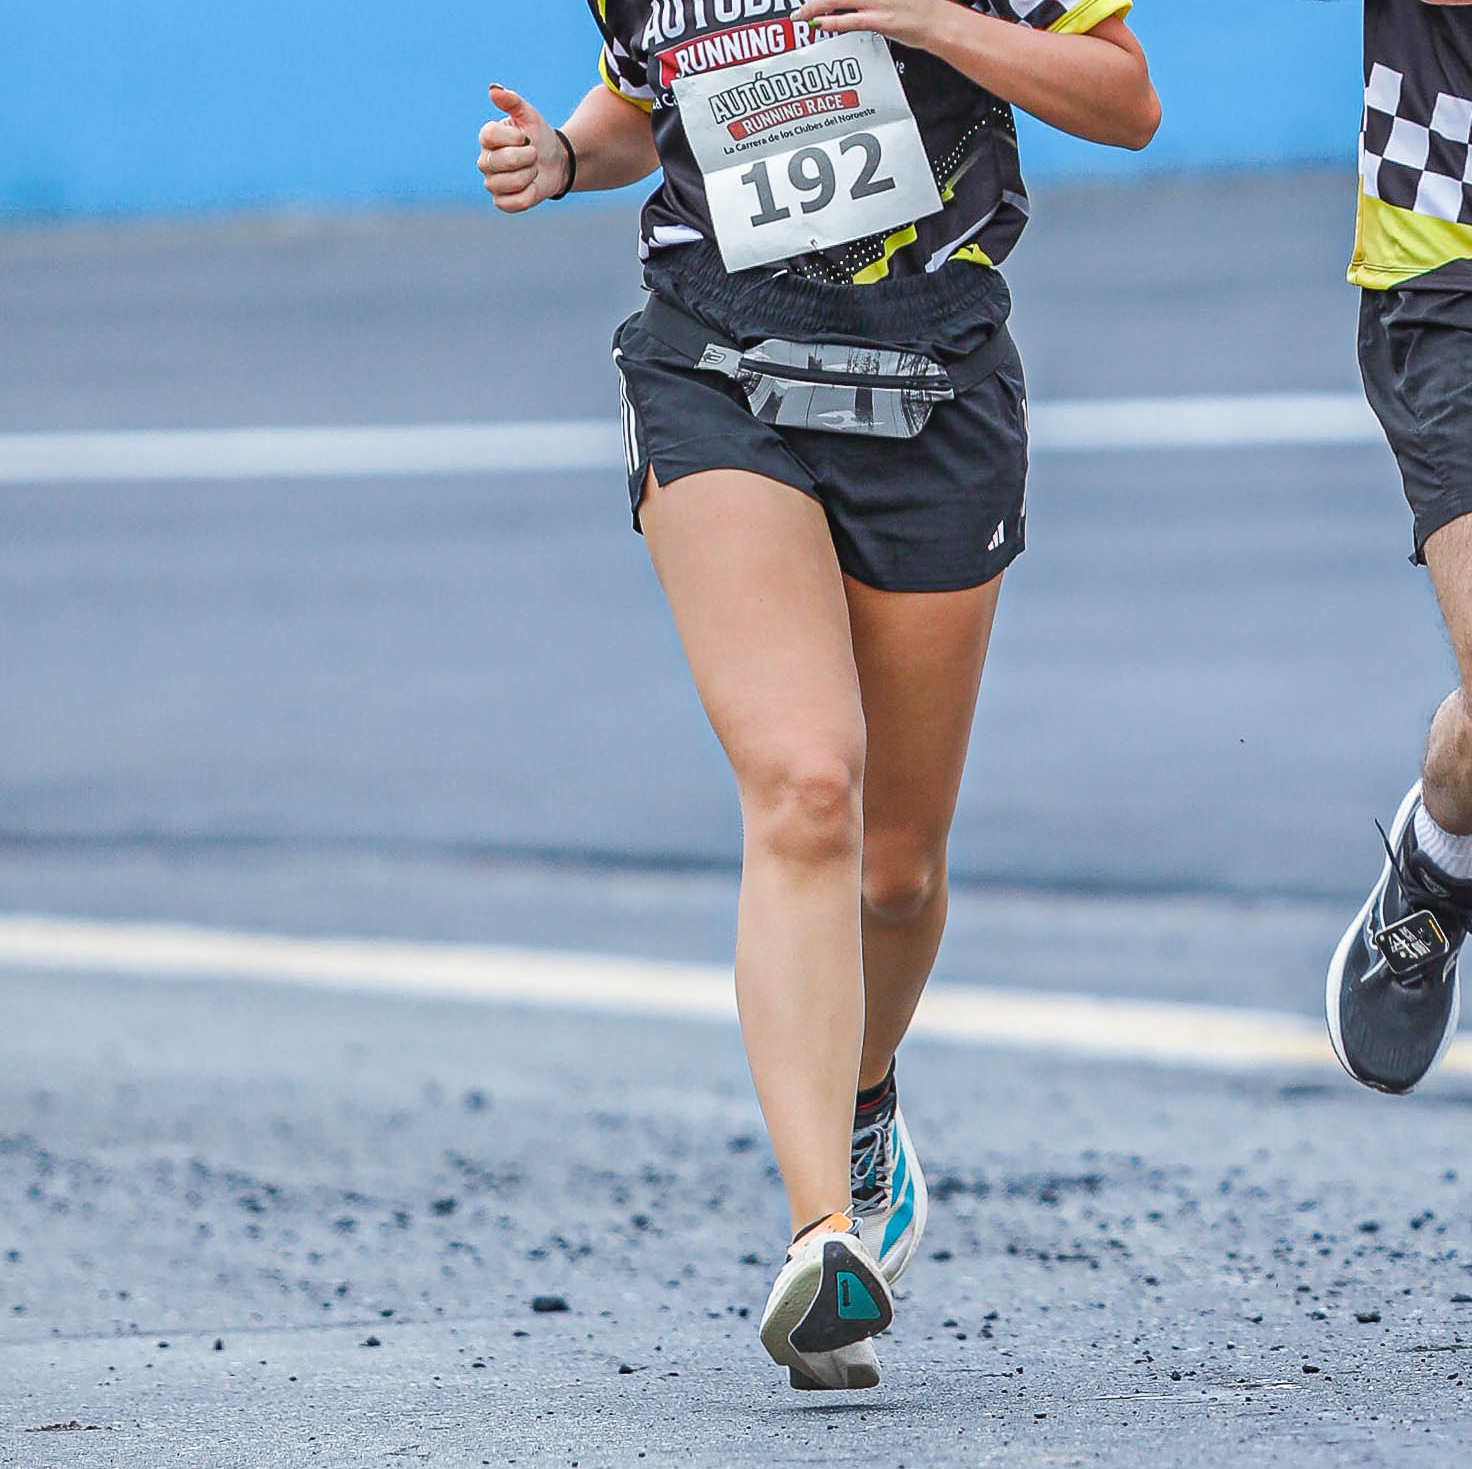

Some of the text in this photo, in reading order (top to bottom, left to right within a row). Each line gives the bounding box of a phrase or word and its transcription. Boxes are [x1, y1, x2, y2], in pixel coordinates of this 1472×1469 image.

[675, 22, 787, 78] RUNNING
[708, 57, 863, 125] AUTÓDROMO
[742, 94, 845, 135] RUNNING RACE
[723, 107, 877, 155] La Carrera de los Clubes del Noroeste
[740, 132, 897, 228] 192
